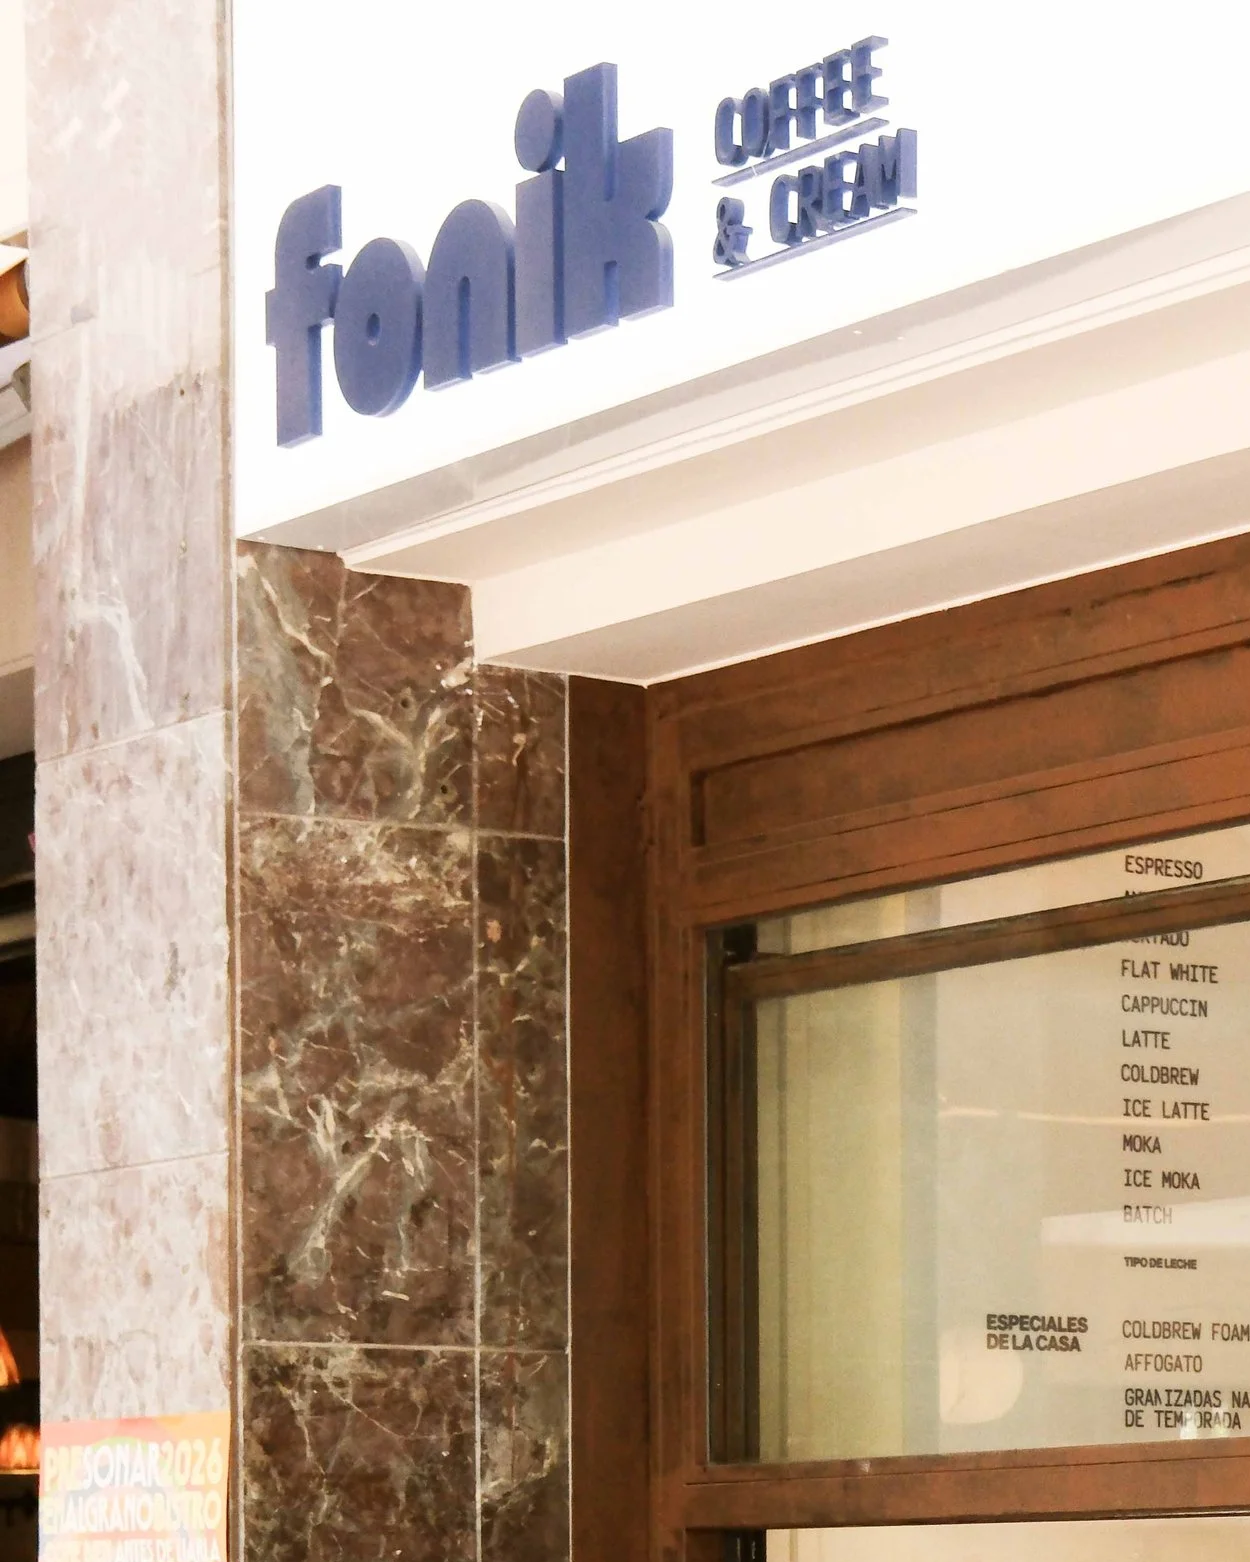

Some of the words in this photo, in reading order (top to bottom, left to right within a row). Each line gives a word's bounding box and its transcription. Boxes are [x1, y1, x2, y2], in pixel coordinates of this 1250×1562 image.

[715, 35, 889, 167] COFFEE
[713, 197, 753, 268] &
[769, 128, 917, 246] CREAM
[265, 61, 674, 448] fonik
[1124, 855, 1203, 879] ESPRESSO
[1121, 959, 1161, 981] FLAT
[1170, 963, 1218, 984] WHITE
[1121, 995, 1208, 1018] CAPPUCCIN
[1122, 1029, 1170, 1050] LATTE
[1121, 1064, 1199, 1086] COLDBREW
[1123, 1099, 1151, 1118] ICE
[1163, 1101, 1210, 1121] LATTE
[1123, 1135, 1161, 1154] MOKA
[1124, 1169, 1152, 1188] ICE
[1162, 1171, 1200, 1190] MOKA
[1123, 1206, 1173, 1225] BATCH
[986, 1314, 1088, 1333] ESPECIALES
[1122, 1320, 1201, 1341] COLDBREW
[1212, 1323, 1250, 1342] FOAM
[986, 1334, 1009, 1350] DE
[1012, 1334, 1033, 1350] LA
[1036, 1335, 1081, 1352] CASA
[1124, 1354, 1202, 1374] AFFOGATO
[1124, 1388, 1221, 1410] GRANIZADAS
[1124, 1410, 1144, 1428] DE
[1156, 1411, 1241, 1430] TEMPORADA
